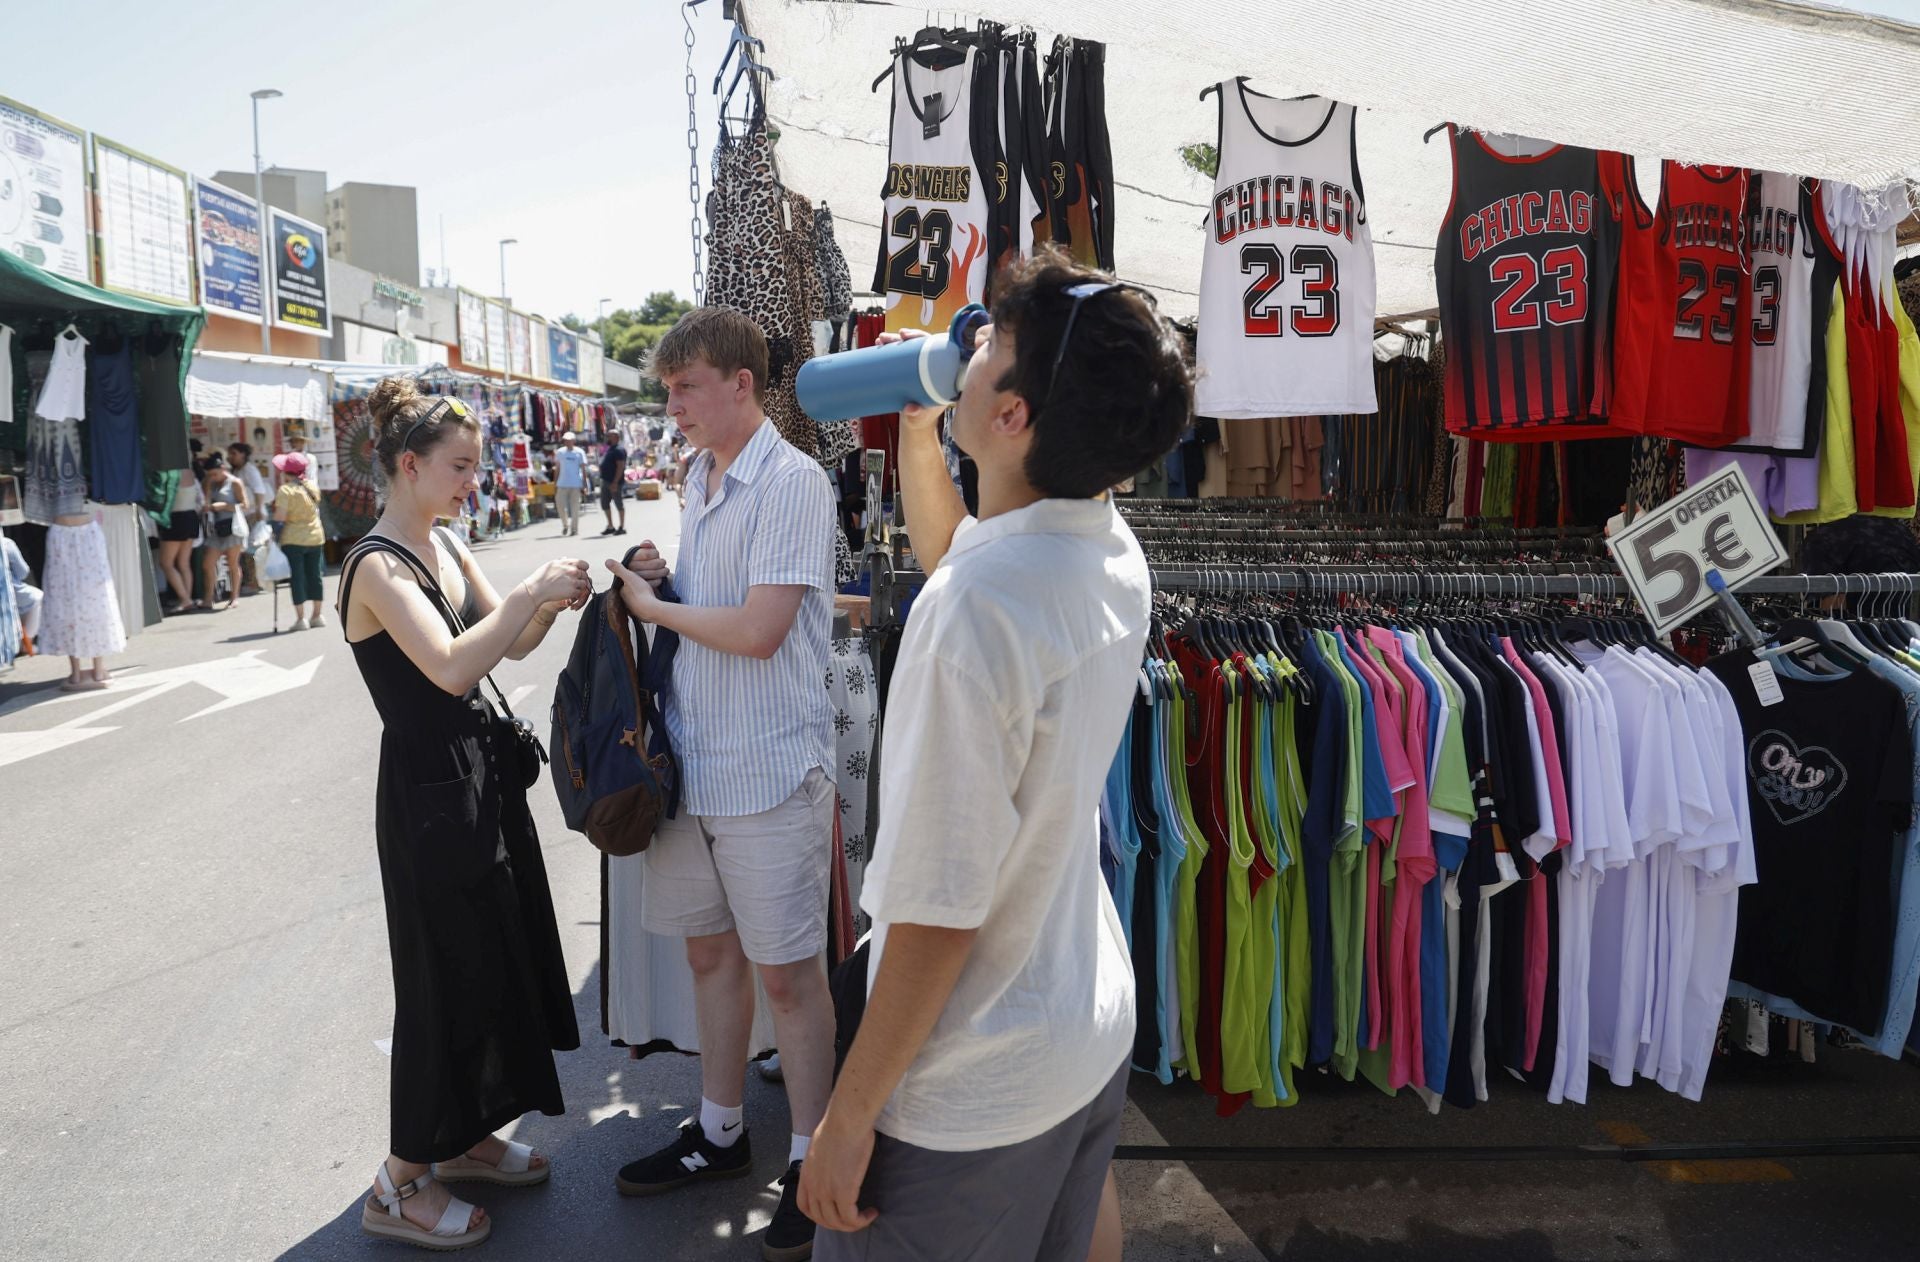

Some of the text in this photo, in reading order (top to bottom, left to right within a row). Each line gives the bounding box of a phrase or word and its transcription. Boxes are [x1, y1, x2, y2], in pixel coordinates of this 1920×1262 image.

[889, 163, 914, 199] OS
[888, 206, 953, 300] 23
[1460, 190, 1599, 262] CHICAG
[1240, 243, 1341, 337] 23
[1489, 244, 1589, 333] 23
[1673, 258, 1740, 345] 23
[1751, 265, 1782, 346] 3
[1675, 478, 1742, 526] OFERTA
